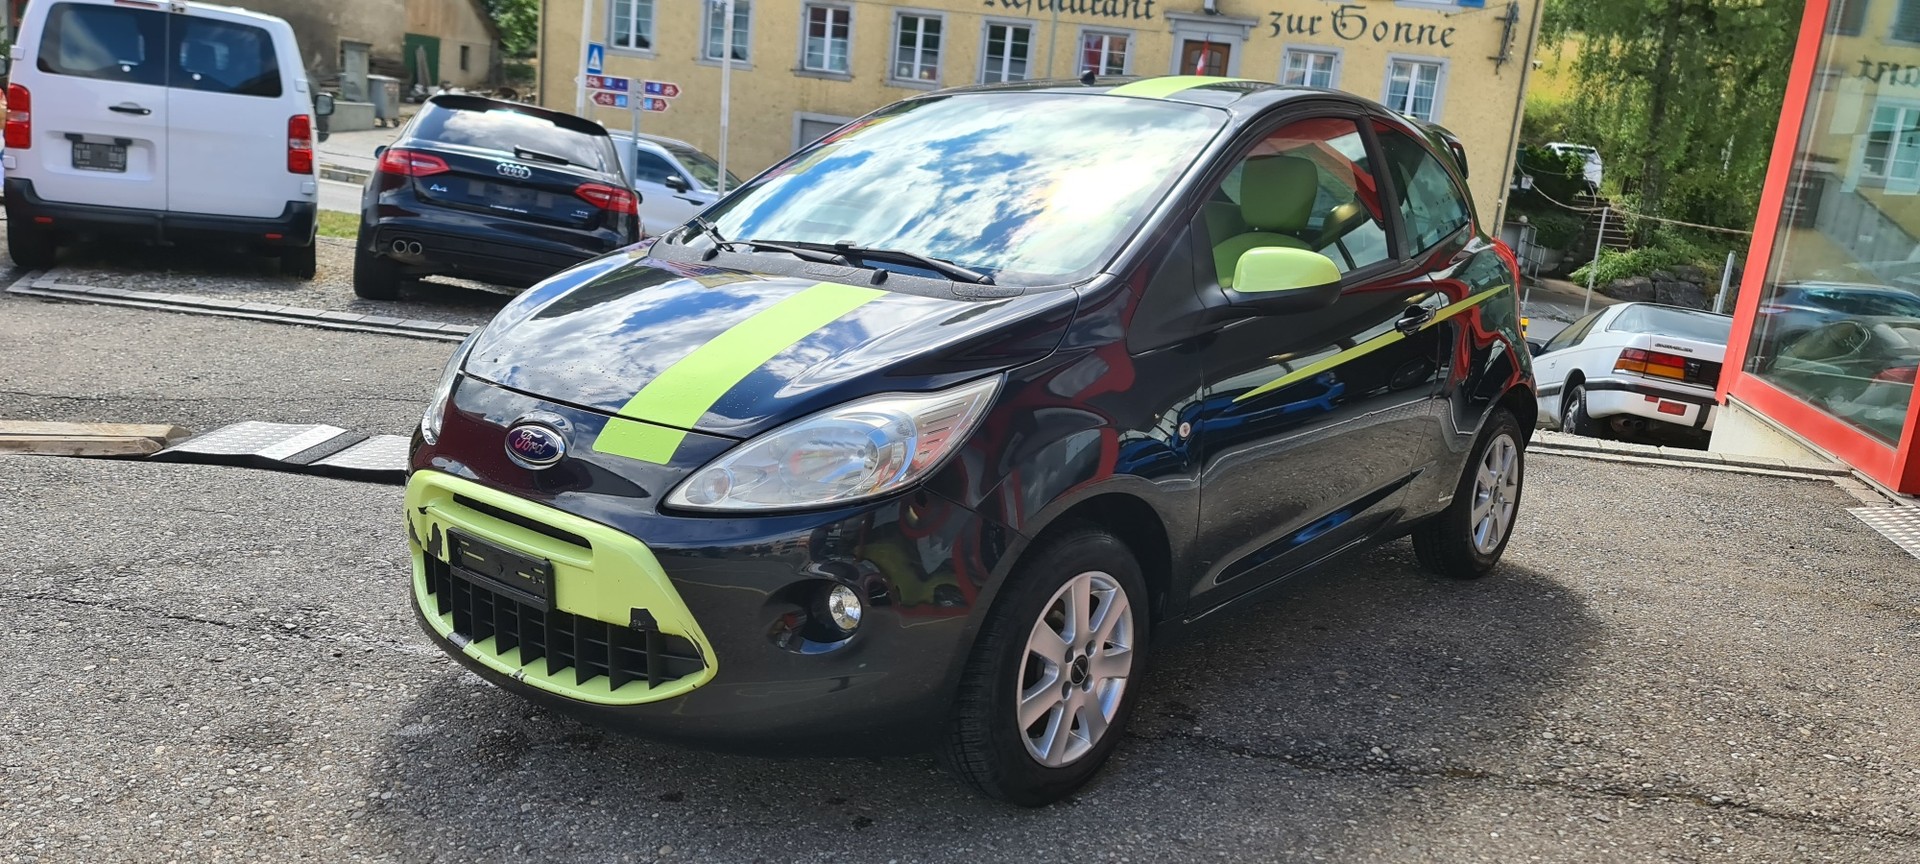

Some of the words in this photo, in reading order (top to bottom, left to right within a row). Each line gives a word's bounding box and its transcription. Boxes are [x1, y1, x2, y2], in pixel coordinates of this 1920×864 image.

[983, 0, 1155, 19] aurant
[1268, 11, 1322, 38] zur
[1331, 5, 1456, 48] Sonne
[430, 183, 448, 193] A4
[514, 429, 548, 455] Ford
